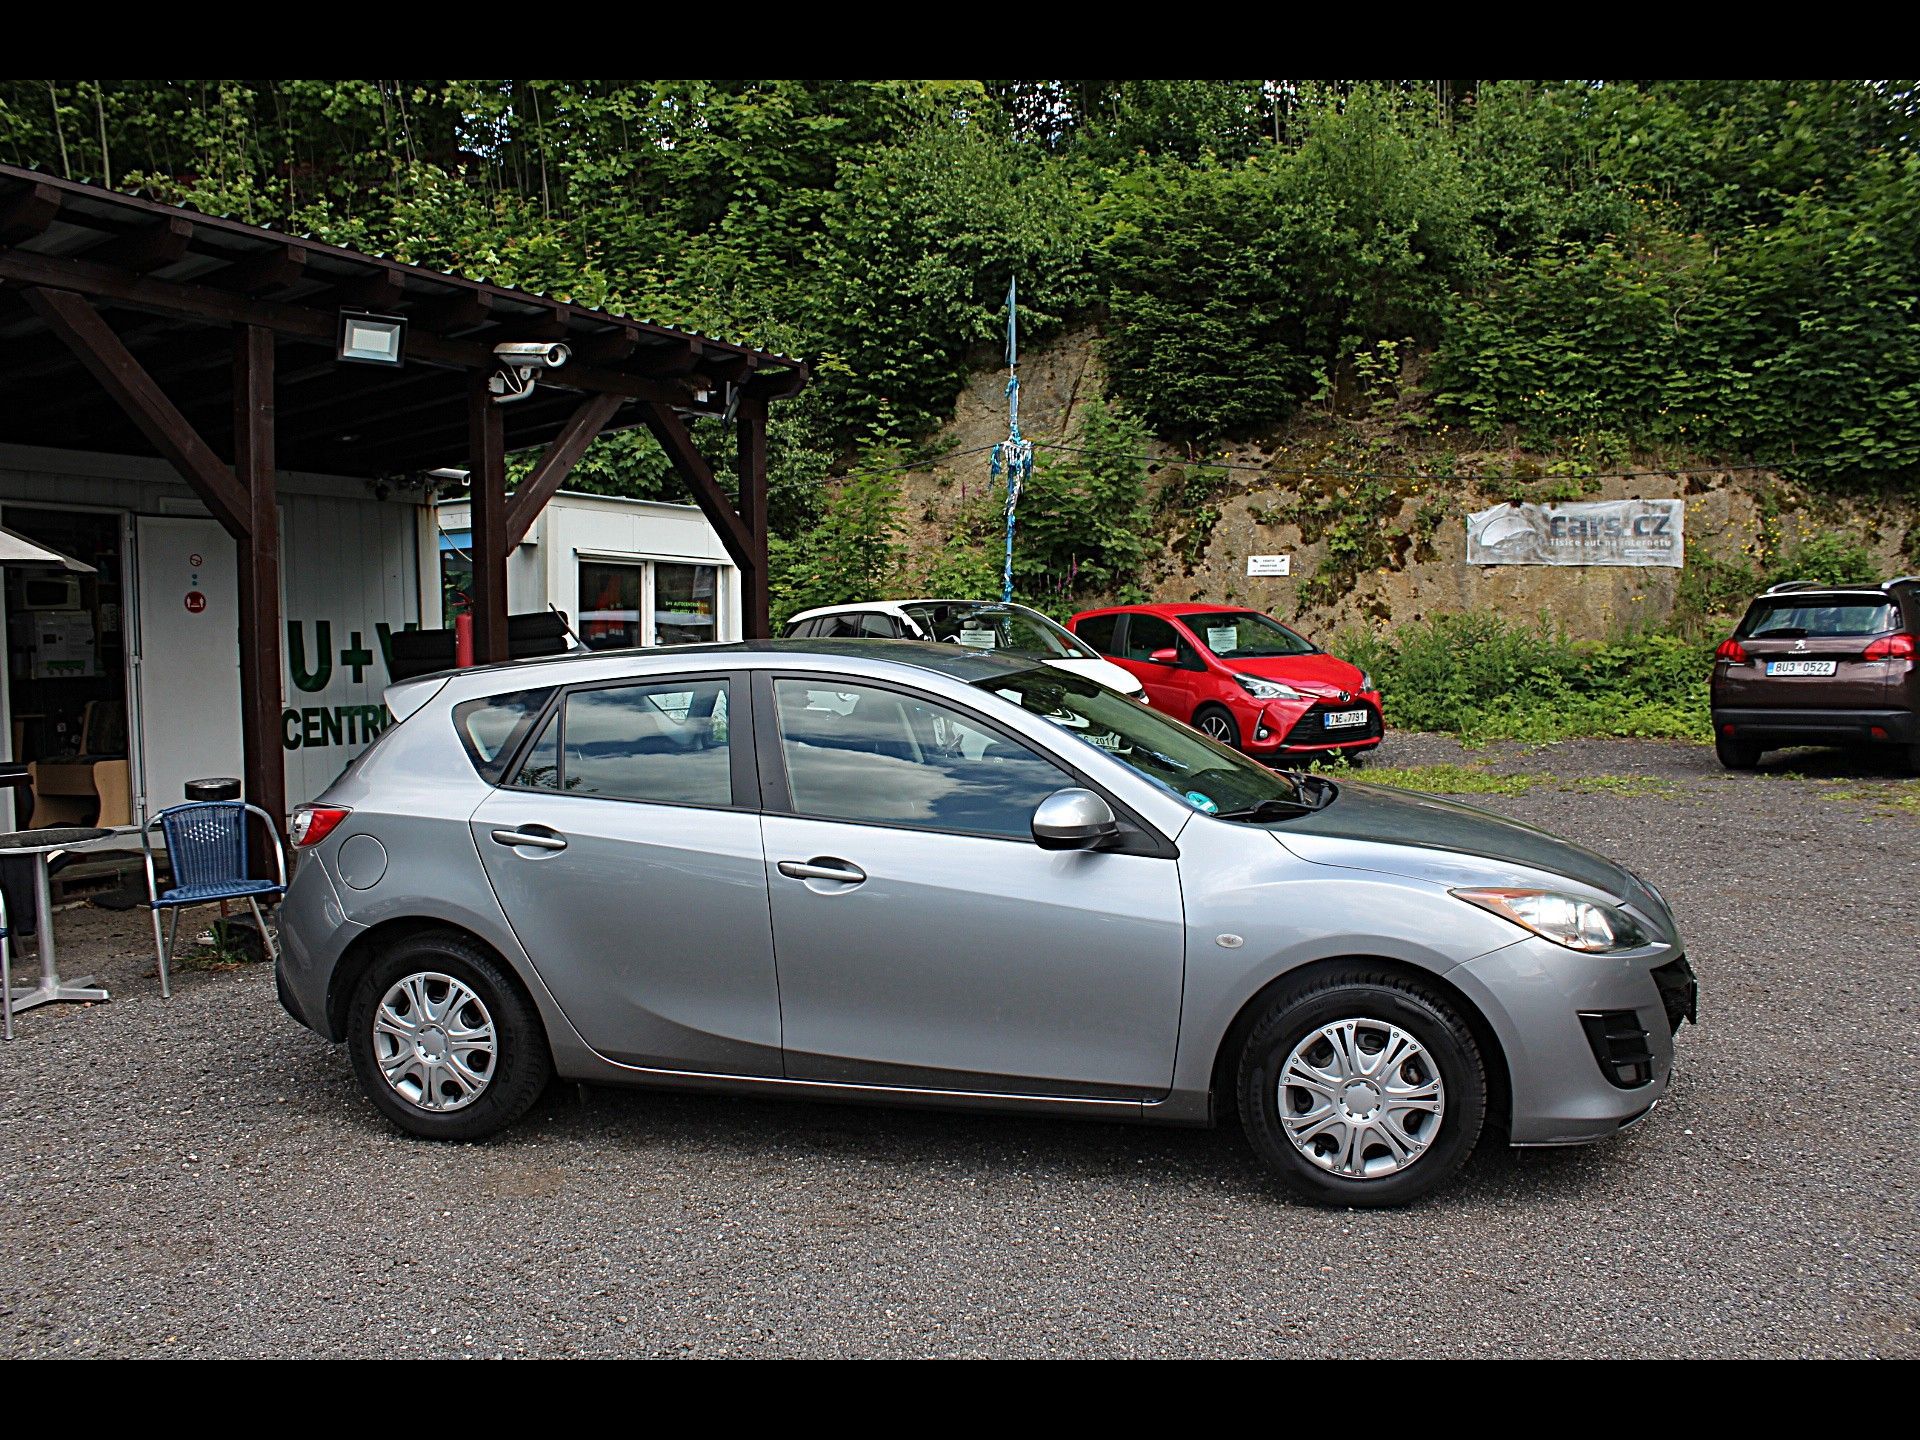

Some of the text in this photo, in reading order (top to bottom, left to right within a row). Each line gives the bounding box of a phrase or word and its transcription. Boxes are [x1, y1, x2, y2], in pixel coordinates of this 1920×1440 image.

[1775, 662, 1831, 673] 8U3 0522
[1348, 711, 1364, 723] 7791
